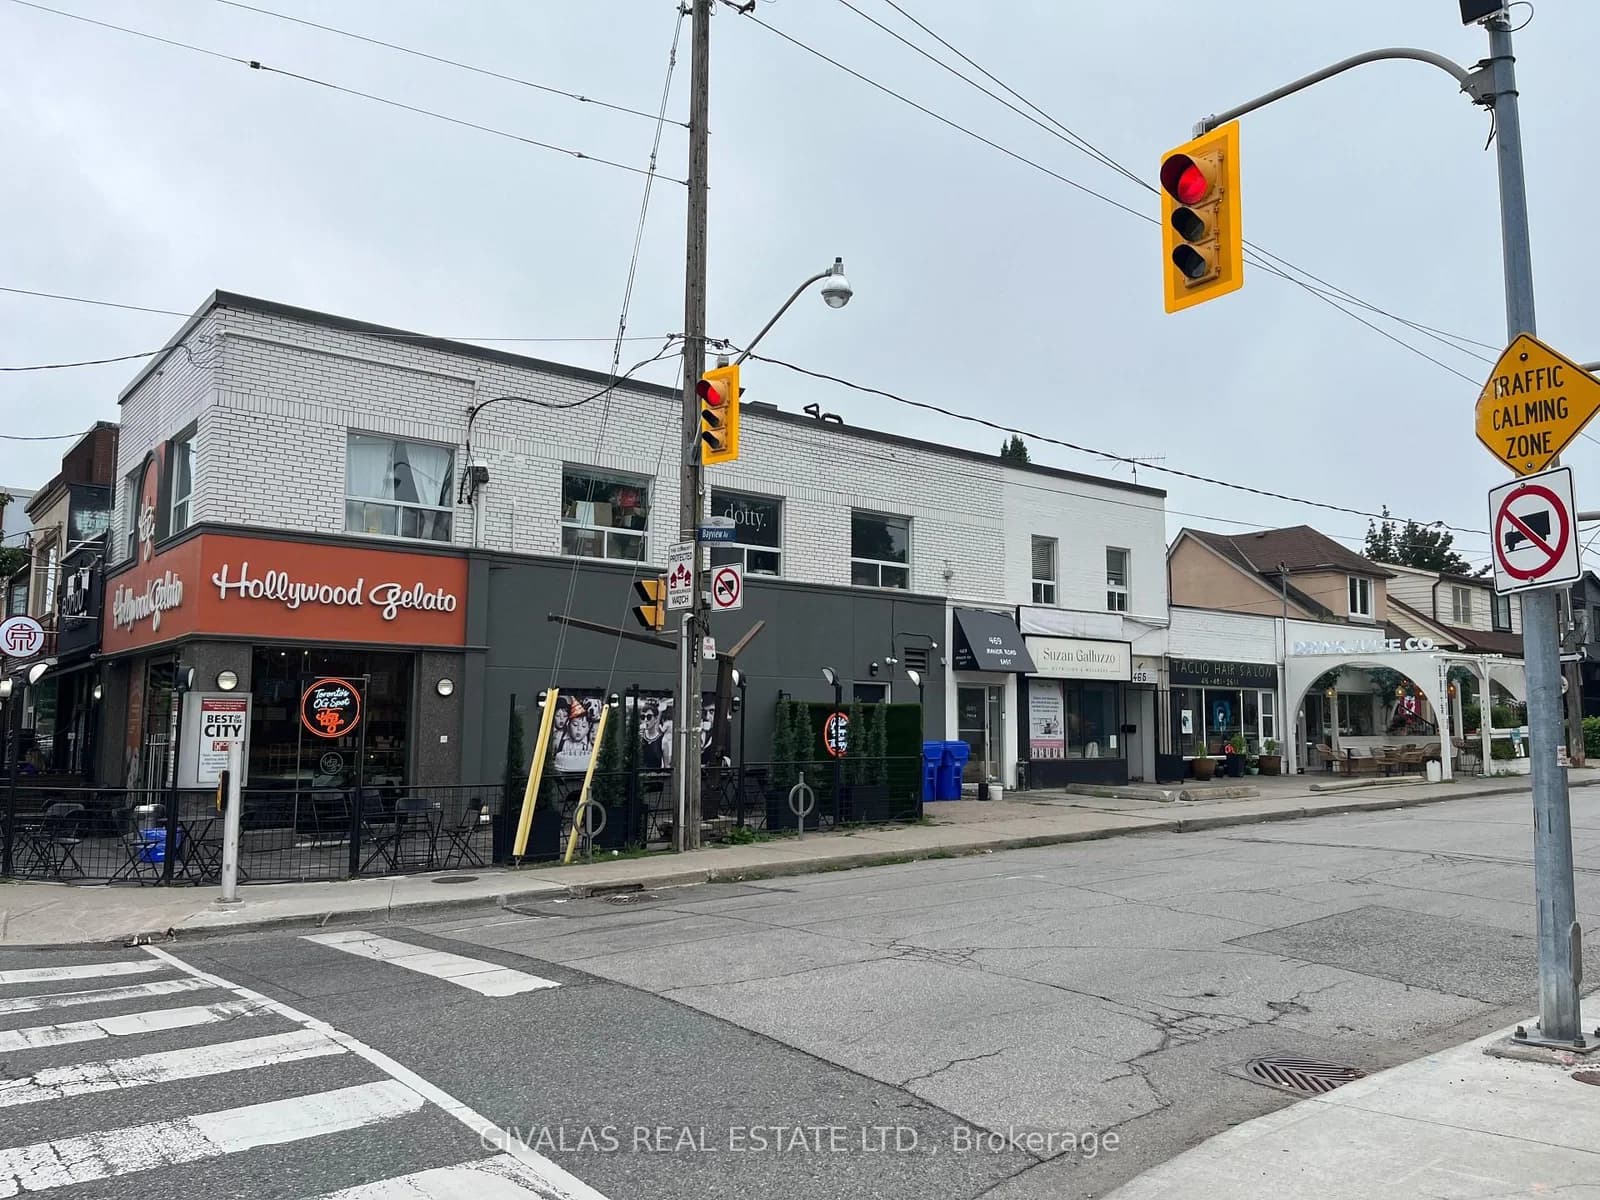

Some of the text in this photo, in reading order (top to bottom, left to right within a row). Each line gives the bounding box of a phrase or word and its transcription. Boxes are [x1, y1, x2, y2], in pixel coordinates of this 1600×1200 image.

[1492, 365, 1564, 400] TRAFFIC
[1492, 396, 1569, 431] CALMING
[1506, 431, 1554, 460] ZONE
[724, 503, 767, 532] dotty.
[702, 528, 723, 540] Bayview
[212, 561, 457, 620] Hollywood Gelato
[113, 579, 152, 632] Hollywood
[672, 595, 689, 606] WATCH
[988, 636, 1002, 645] 469
[1043, 647, 1116, 664] Suzan Galluzzo
[1214, 663, 1235, 675] HAIR
[1240, 664, 1273, 678] SALON
[314, 687, 350, 699] Toronto's
[313, 697, 351, 709] OG Spot
[207, 714, 234, 723] BEST
[204, 724, 242, 738] CITY
